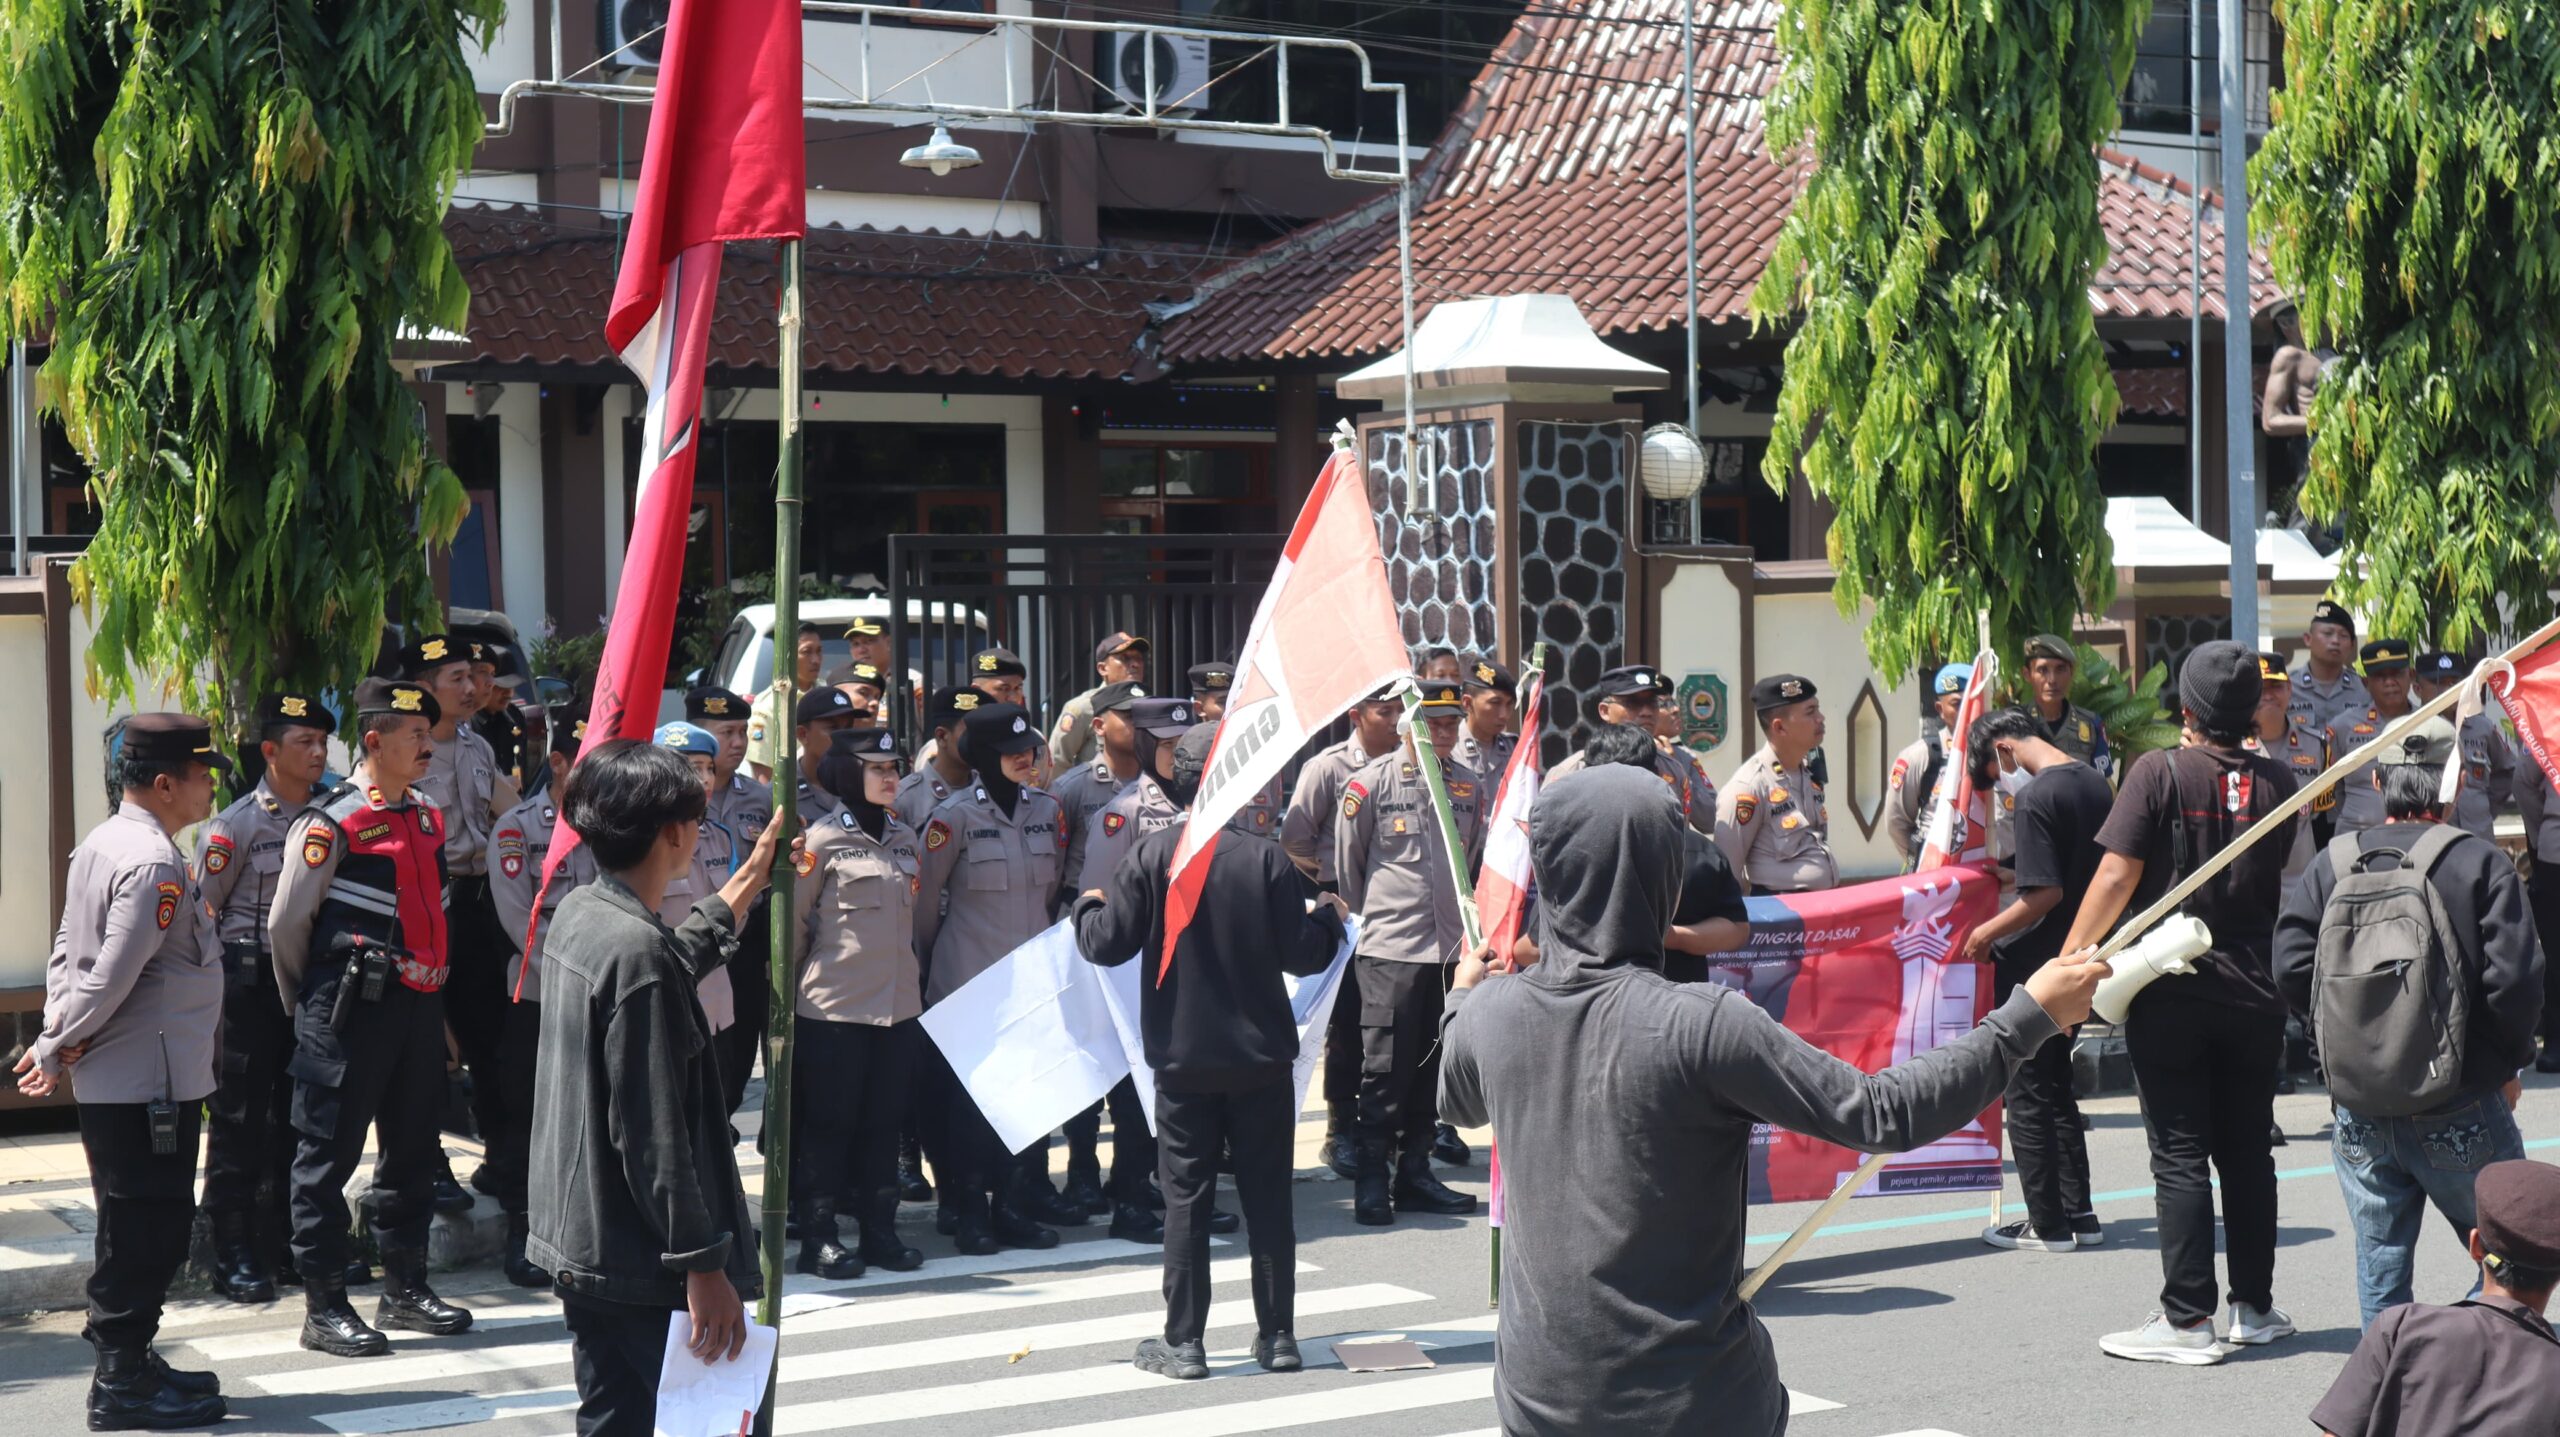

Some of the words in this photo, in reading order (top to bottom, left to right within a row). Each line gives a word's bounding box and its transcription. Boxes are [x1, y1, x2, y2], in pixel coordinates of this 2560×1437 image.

[2286, 703, 2313, 711] AJAR
[359, 823, 390, 840] SISWANTO
[1750, 930, 1811, 945] TINGKAT
[1812, 926, 1861, 943] DASAR
[1890, 1177, 1918, 1187] pejuang
[1948, 1172, 1975, 1184] pemikir
